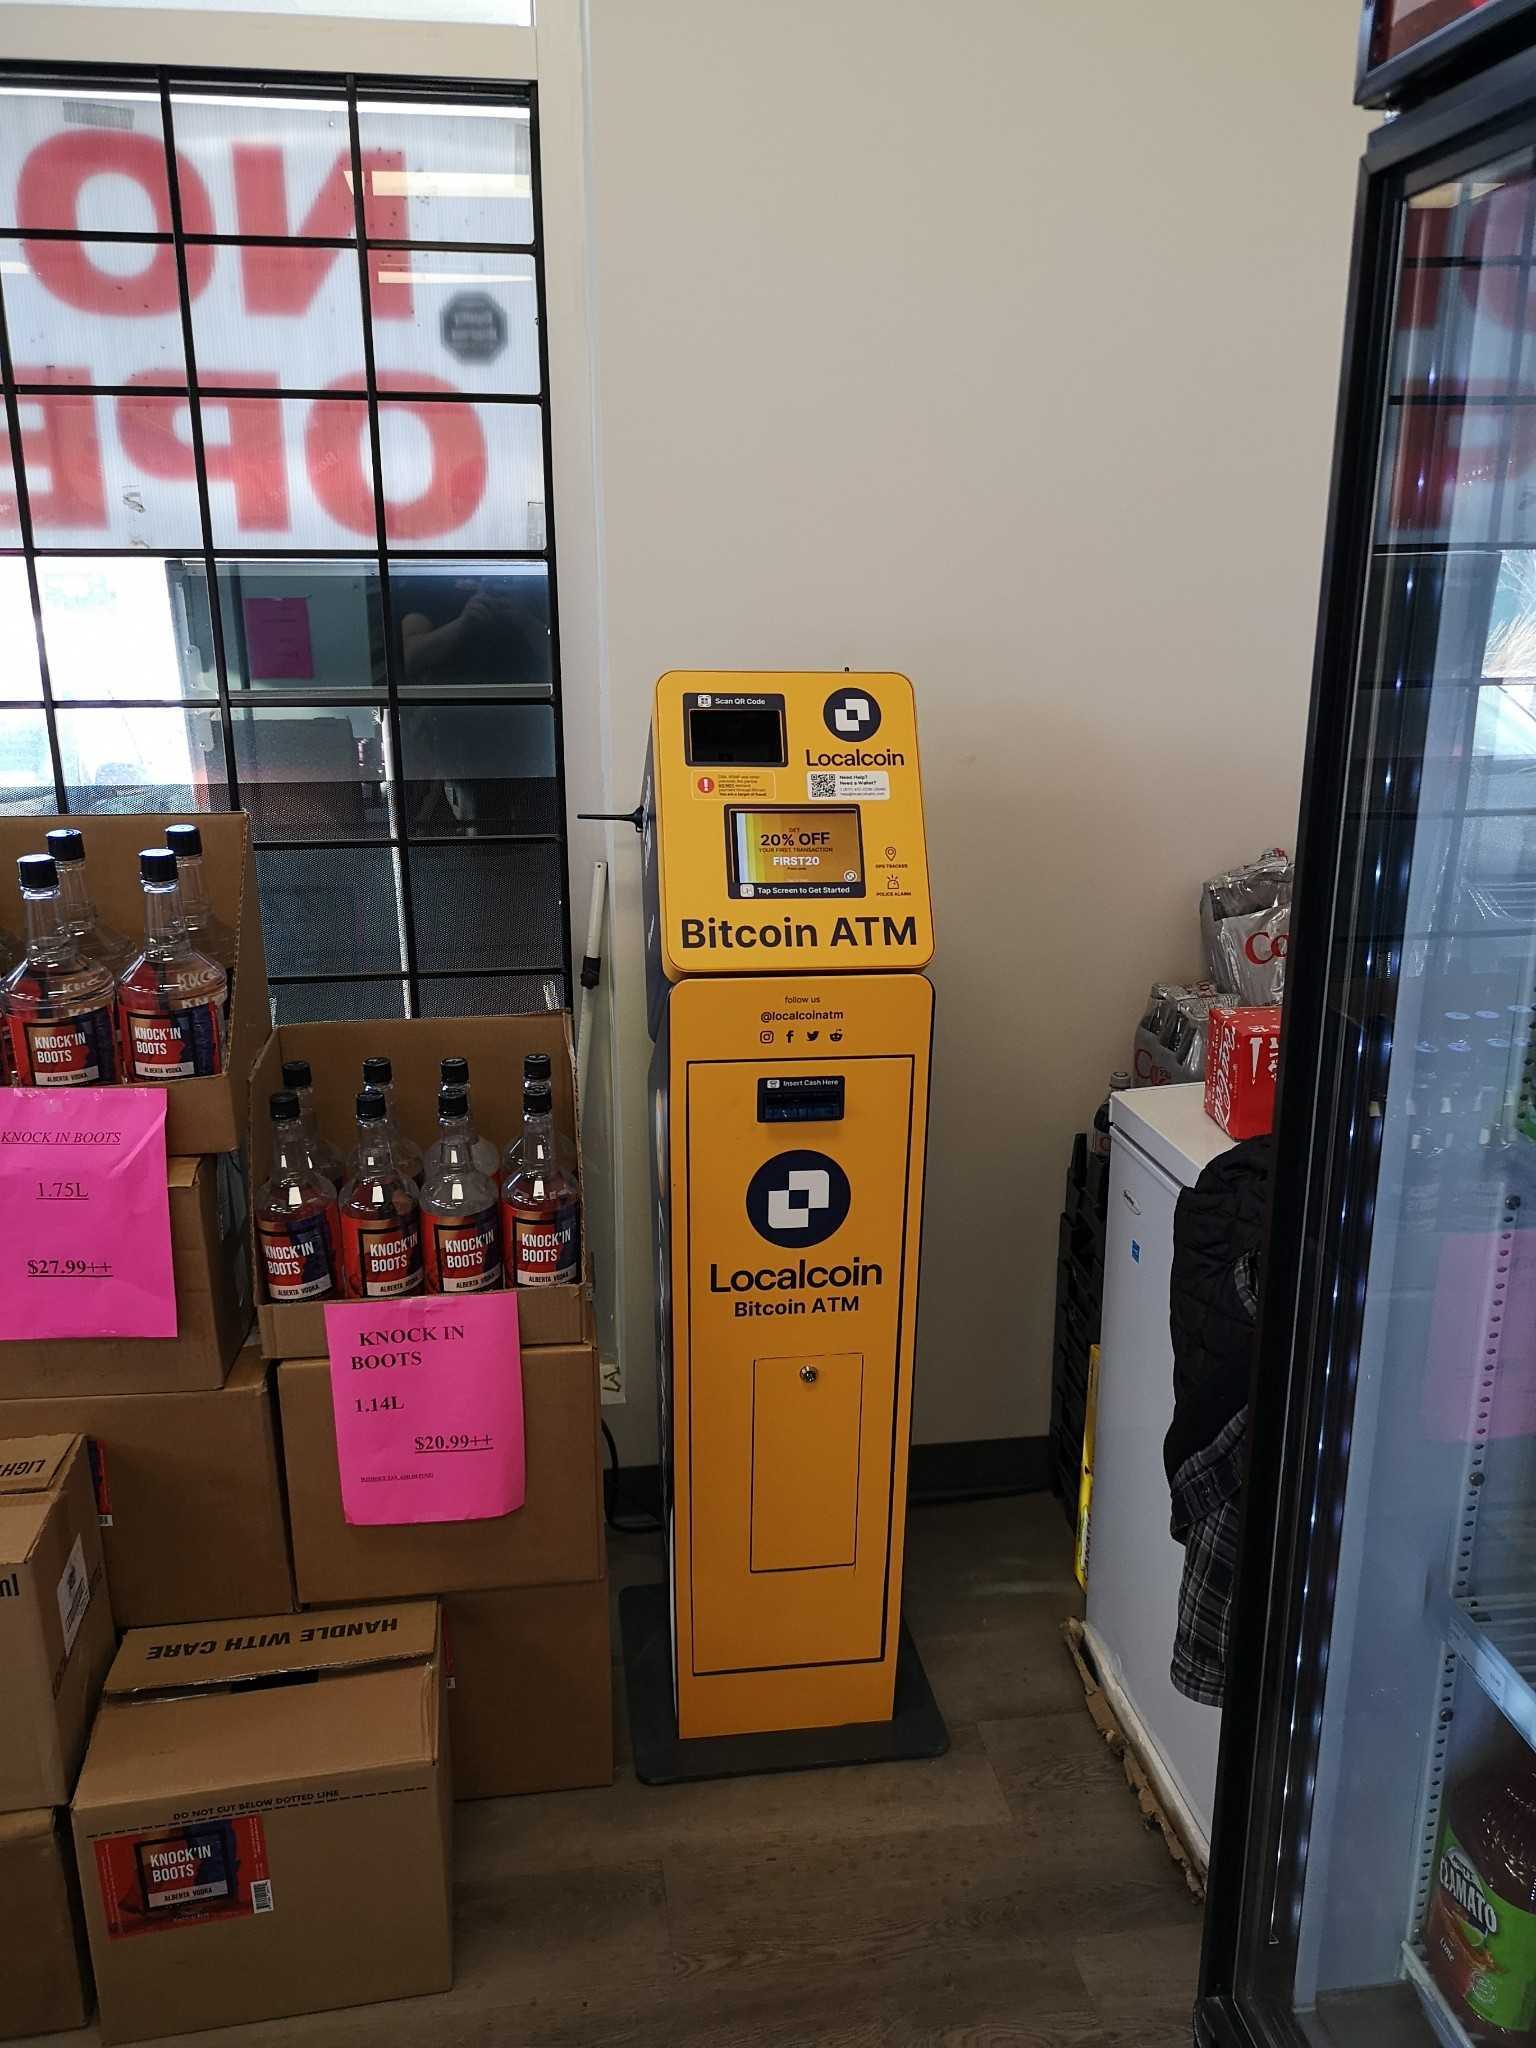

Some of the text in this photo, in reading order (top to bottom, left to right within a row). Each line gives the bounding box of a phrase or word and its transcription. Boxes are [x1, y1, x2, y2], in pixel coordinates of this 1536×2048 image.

[715, 697, 732, 705] Scan
[805, 749, 905, 767] Localcoin
[760, 832, 831, 847] 20% OFF
[773, 856, 820, 866] FIRST20
[757, 886, 851, 896] Tap Screen to Get Started
[681, 915, 918, 949] Bitcoin ATM
[1245, 932, 1290, 965] Co
[784, 995, 821, 1005] follow us
[760, 1009, 844, 1023] @localcoinatm
[34, 1031, 86, 1049] KNOCK'IN
[134, 1026, 182, 1041] KNOCK'IN
[37, 1050, 72, 1064] BOOTS
[136, 1043, 167, 1056] BOOTS
[804, 1079, 821, 1087] Cash
[1, 1131, 121, 1145] KNOCK IN BOOTS
[36, 1182, 89, 1199] 1.75L
[370, 1232, 418, 1257] KNOCK'IN
[445, 1229, 495, 1253] KNOCK'IN
[522, 1228, 571, 1247] KNOCK'IN
[264, 1241, 315, 1260] KNOCK'IN
[522, 1249, 558, 1263] BOOTS
[27, 1259, 113, 1277] $27.99++
[267, 1262, 301, 1276] BOOTS
[371, 1255, 408, 1273] BOOTS
[446, 1251, 483, 1269] BOOTS
[455, 1279, 479, 1289] ALBERTA
[528, 1275, 552, 1283] ALBERTA
[710, 1257, 883, 1293] Localcoin
[277, 1288, 300, 1297] ALBERTA
[380, 1283, 403, 1293] ALBERTA
[733, 1295, 860, 1318] Bitcoin ATM
[359, 1325, 465, 1347] KNOCK IN
[351, 1351, 423, 1370] BOOTS
[354, 1396, 405, 1413] 1.14L
[415, 1434, 494, 1453] $20.99++
[146, 1617, 399, 1661] HANDLE WITH CARE
[173, 1789, 340, 1821] DO NOT CUT BELOW DOTTED LINE
[150, 1844, 212, 1868] KNOCK'IN
[152, 1863, 195, 1883] BOOTS
[1439, 1855, 1498, 1934] CLAMATO
